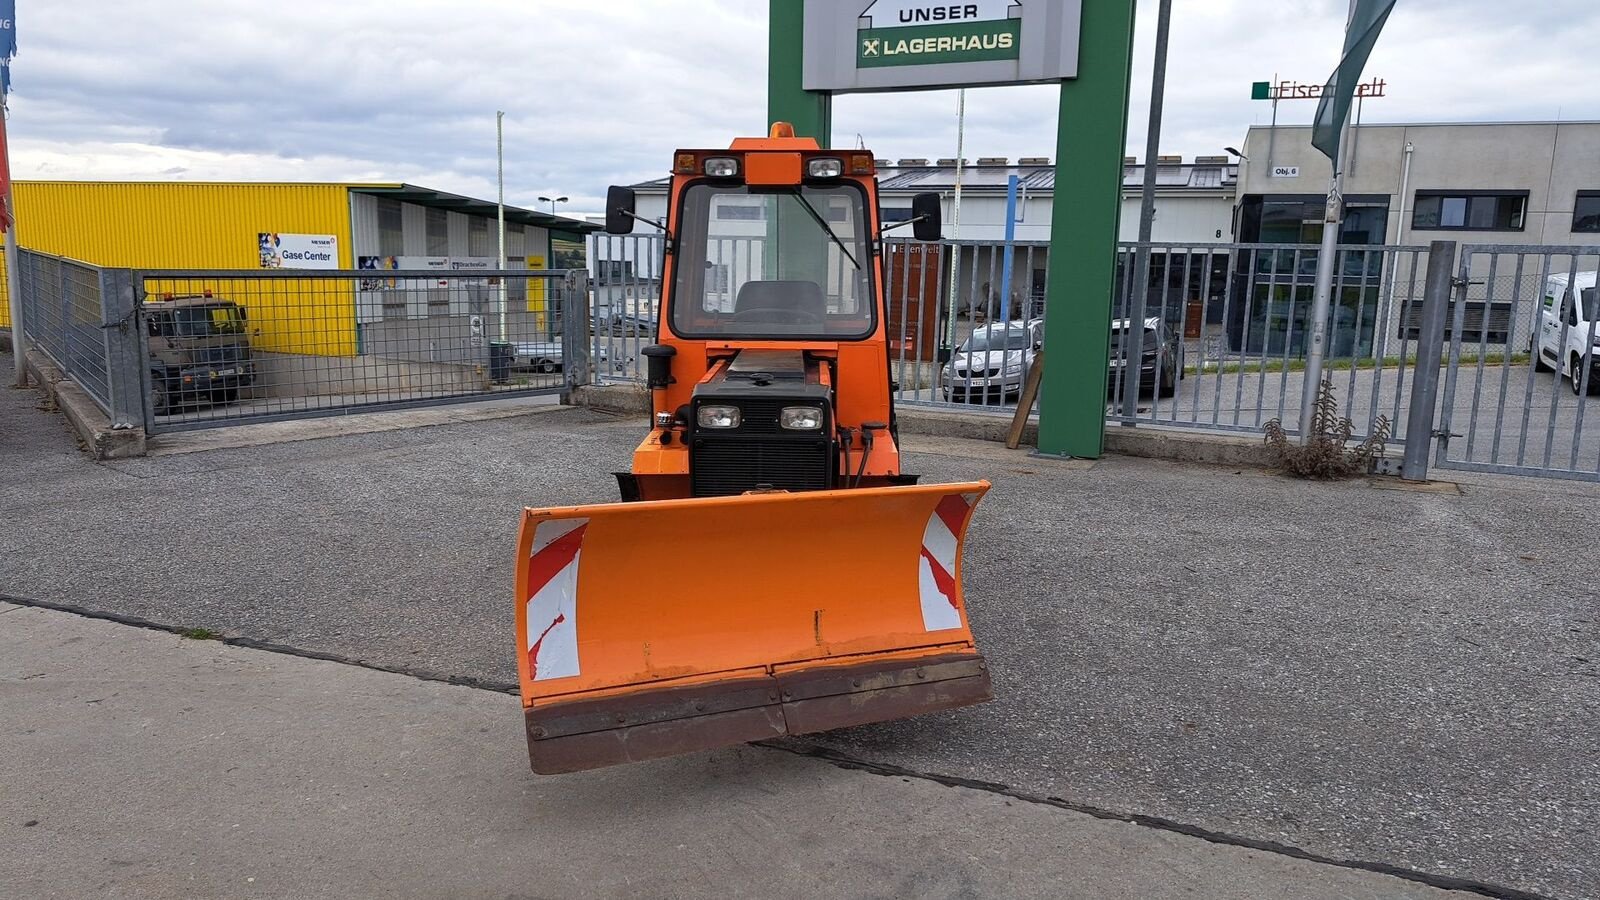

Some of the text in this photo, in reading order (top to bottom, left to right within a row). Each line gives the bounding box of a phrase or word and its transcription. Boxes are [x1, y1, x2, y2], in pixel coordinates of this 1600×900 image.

[899, 5, 978, 23] UNSER
[883, 33, 1013, 55] LAGERHAUS
[1280, 77, 1387, 99] Eiseelt
[1275, 168, 1292, 176] Obj.
[1215, 229, 1222, 239] 8
[282, 249, 331, 261] Gase Center
